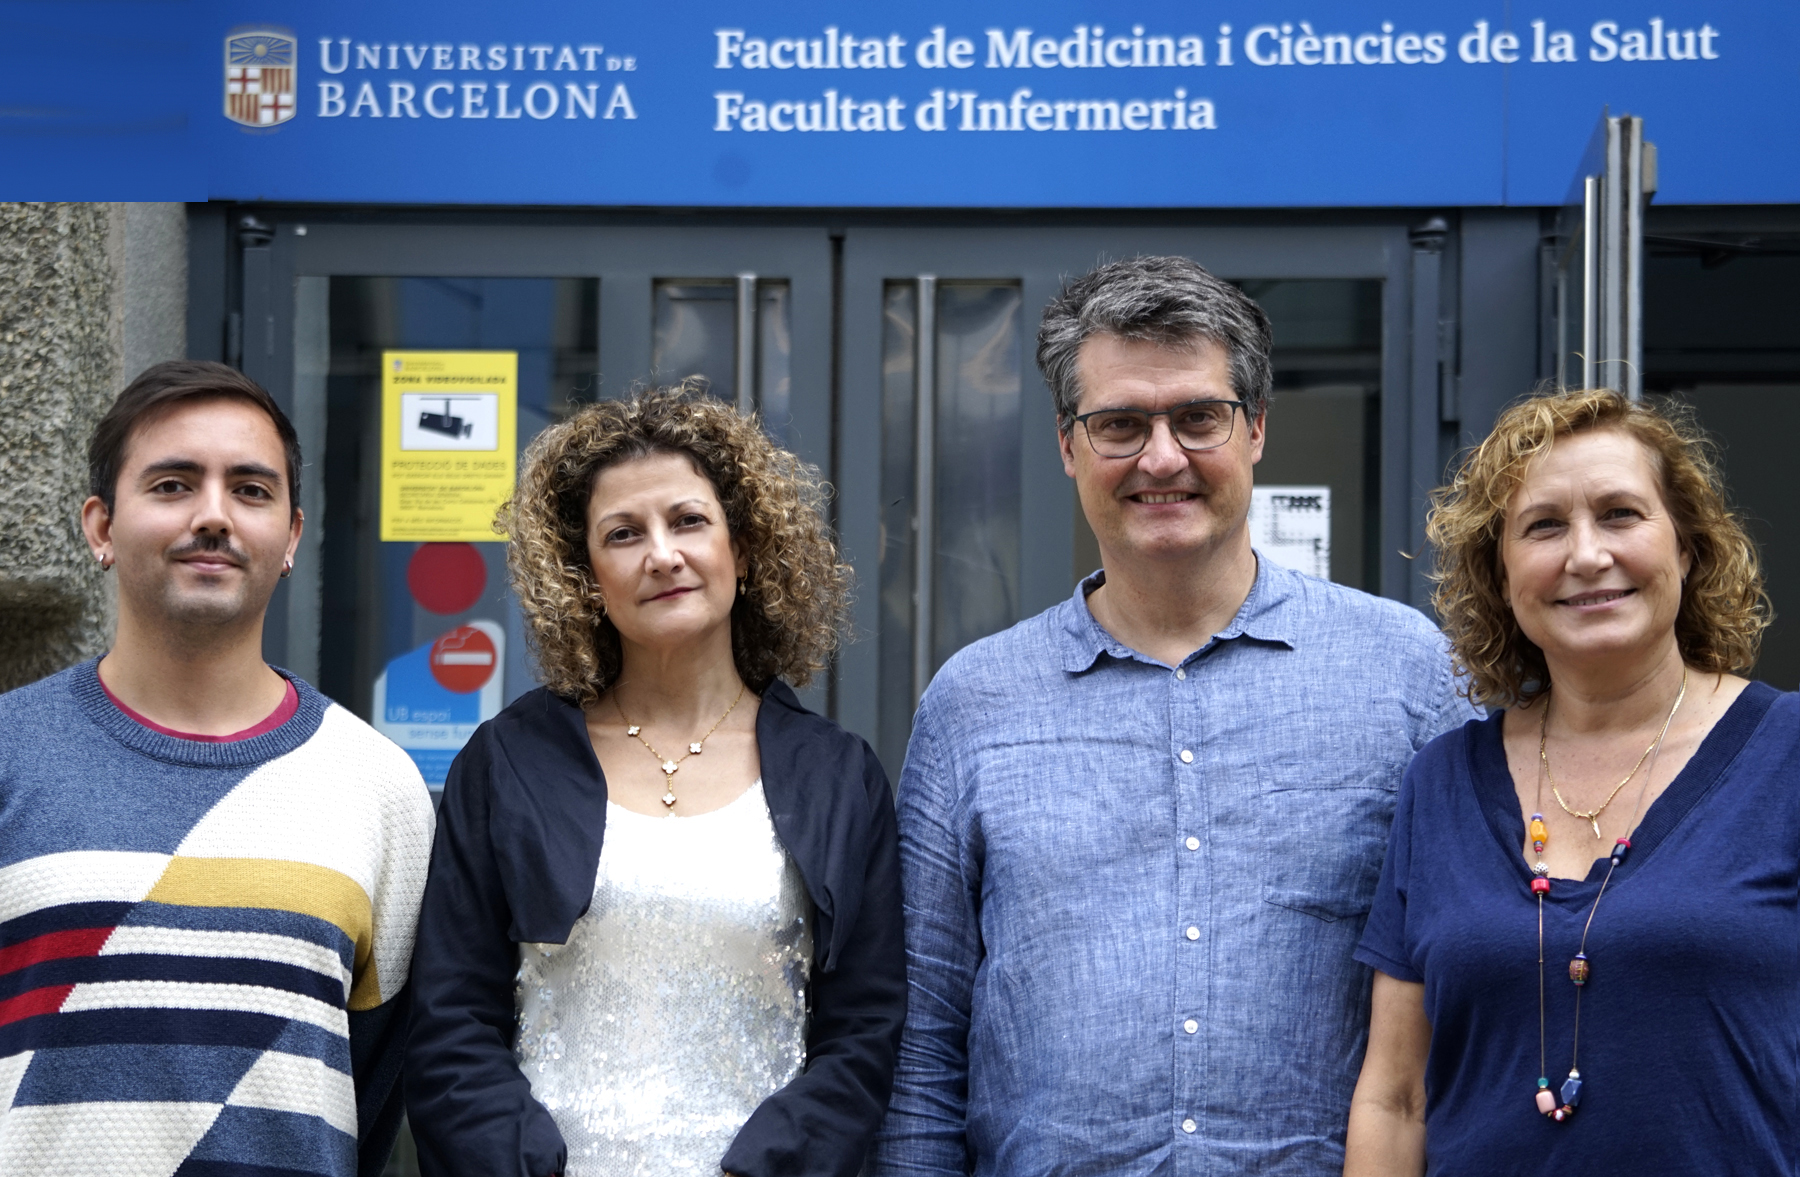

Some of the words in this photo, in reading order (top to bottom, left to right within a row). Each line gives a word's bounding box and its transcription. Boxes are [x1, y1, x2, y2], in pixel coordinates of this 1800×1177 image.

[319, 39, 604, 74] UNIVERSITAT
[607, 56, 637, 72] DE
[715, 28, 906, 70] Facultat
[916, 27, 974, 69] de
[987, 26, 1205, 69] Medicina
[1217, 25, 1233, 65] i
[1246, 22, 1446, 66] Ciències
[1459, 21, 1519, 64] de
[1532, 19, 1577, 63] la
[1590, 18, 1719, 62] Salut
[318, 82, 637, 120] BARCELONA
[714, 90, 905, 132] Facultat
[915, 88, 1216, 132] d’Infermeria
[455, 460, 469, 471] DE
[388, 707, 410, 722] UB
